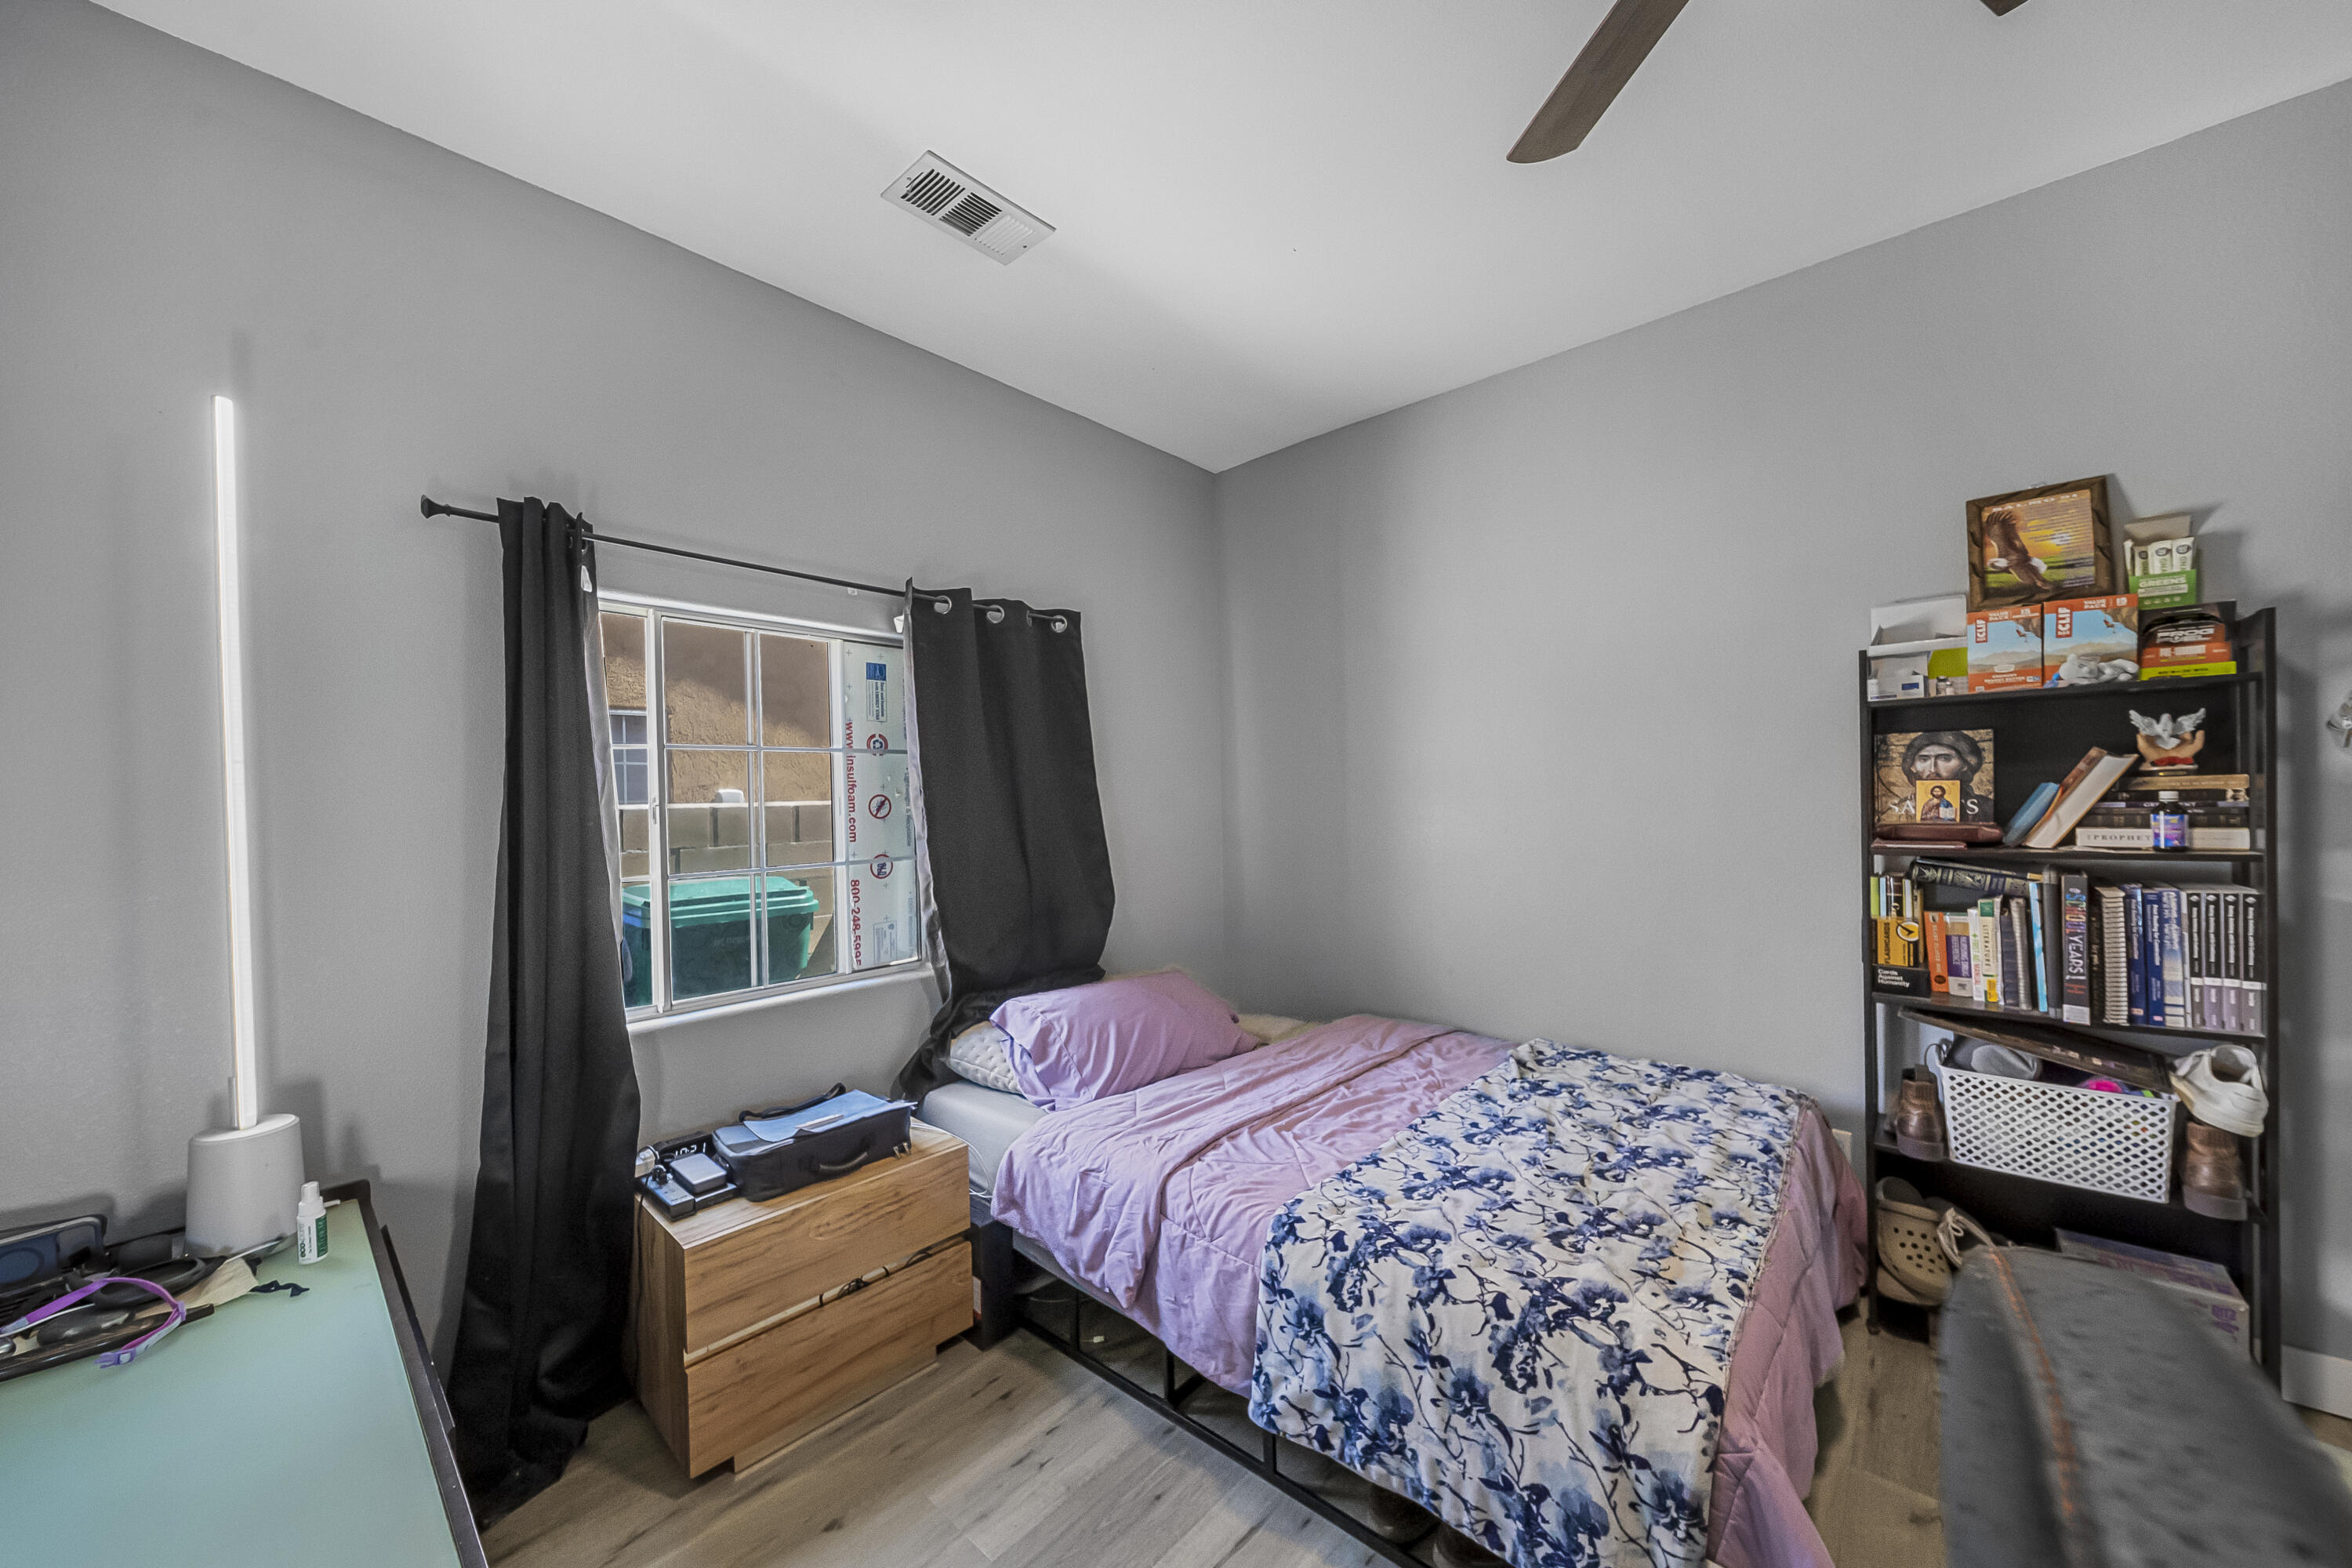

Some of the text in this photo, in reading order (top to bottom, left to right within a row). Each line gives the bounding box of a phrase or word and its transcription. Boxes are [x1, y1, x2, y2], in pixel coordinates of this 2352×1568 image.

[846, 721, 857, 843] wwwinsulfoam.com
[1889, 799, 1980, 815] SAS
[2065, 894, 2086, 934] SCHOOL
[1983, 925, 1991, 967] LITERATURE
[1878, 979, 1911, 988] Humanity
